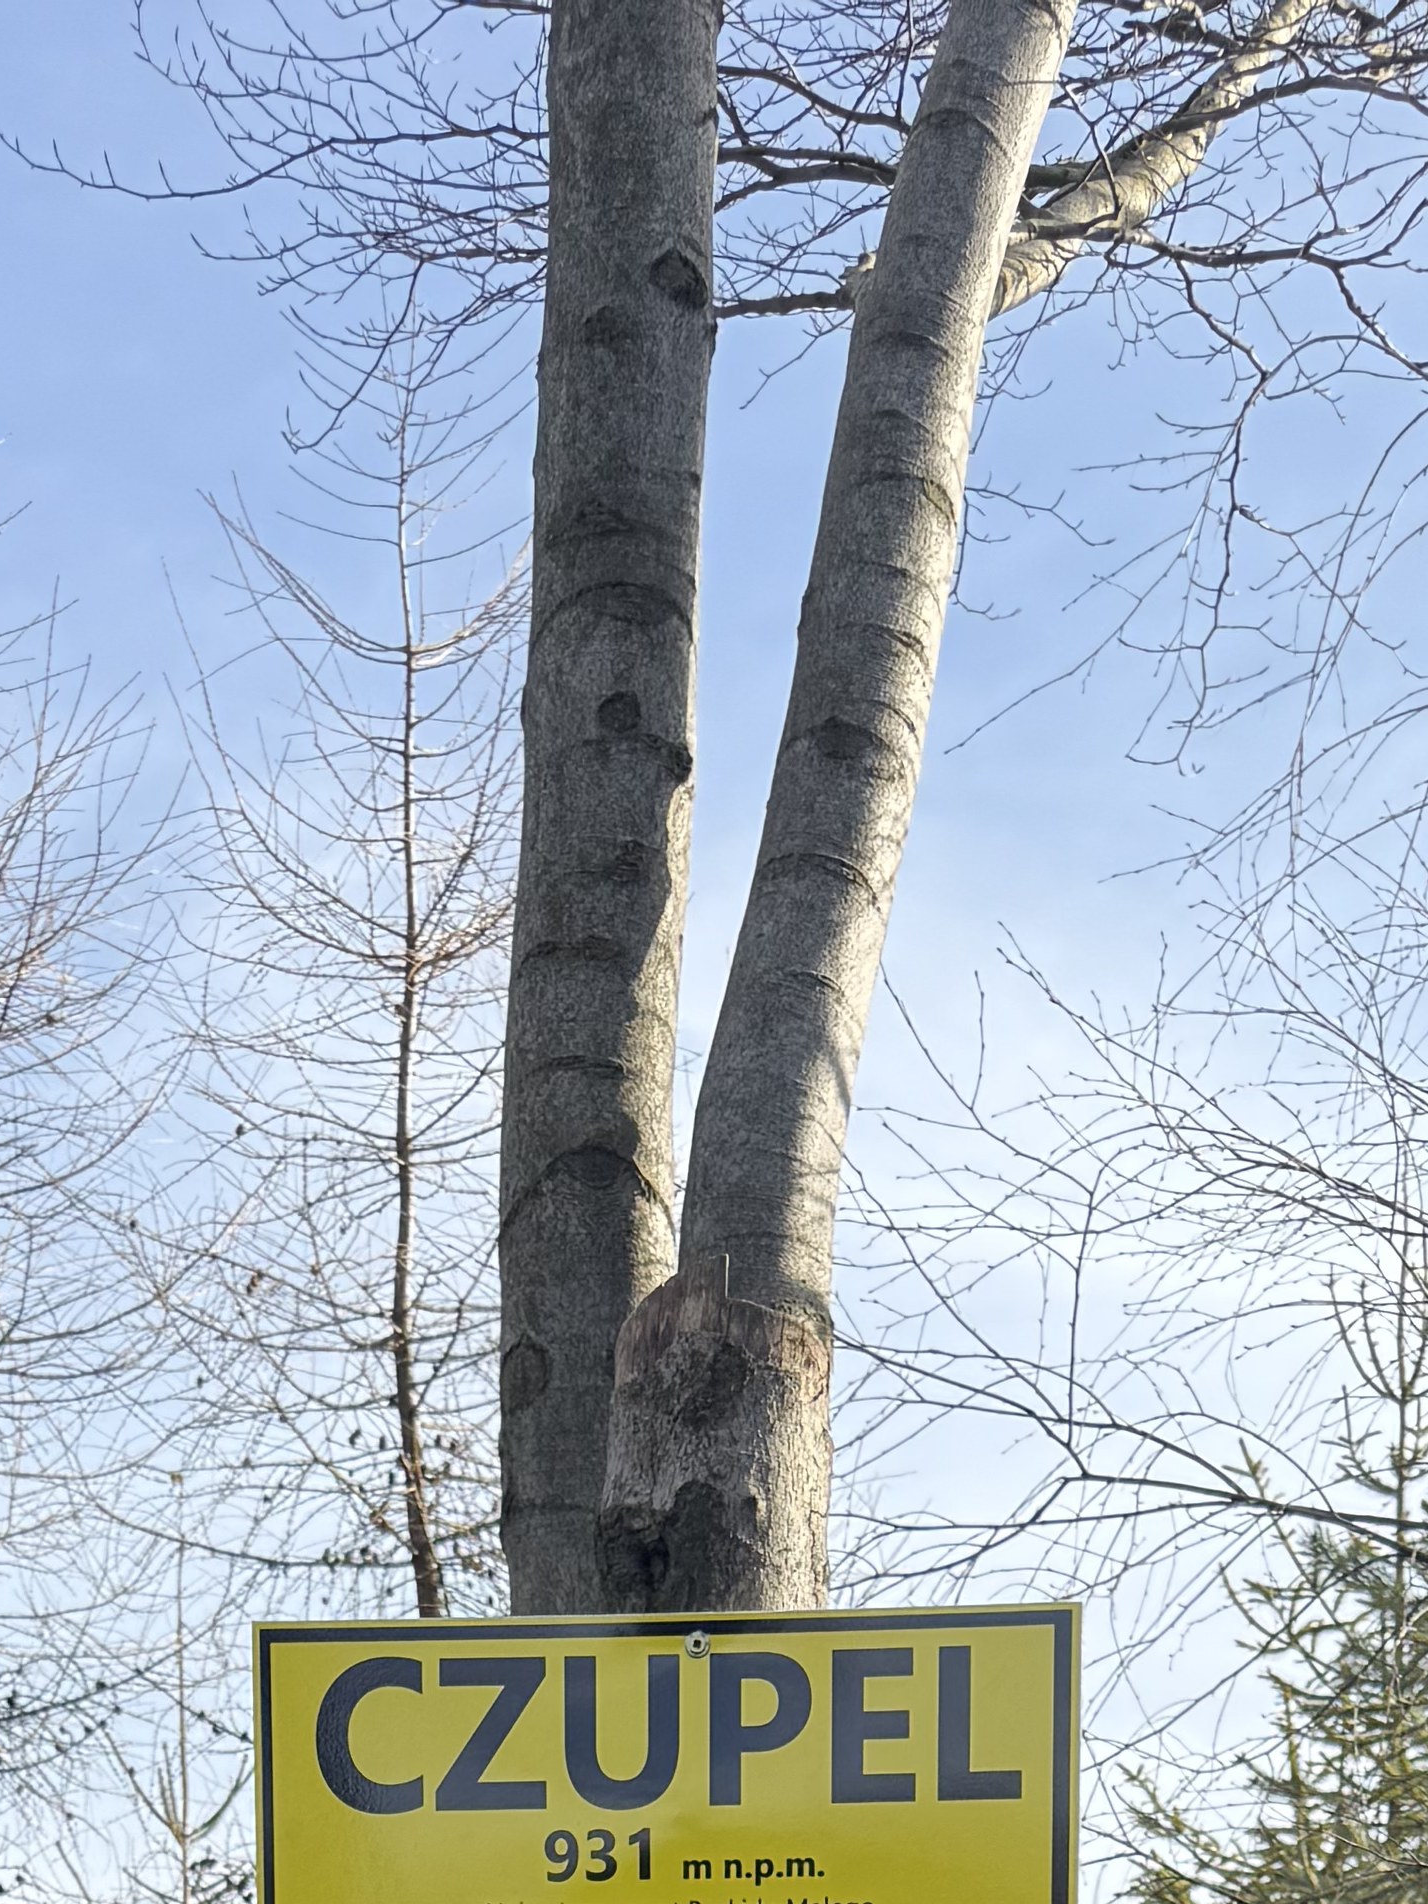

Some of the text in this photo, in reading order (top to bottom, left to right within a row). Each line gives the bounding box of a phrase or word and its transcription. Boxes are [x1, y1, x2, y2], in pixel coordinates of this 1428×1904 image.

[316, 1645, 1022, 1815] CZUPEL
[544, 1828, 825, 1887] 931 m n.p.m.
